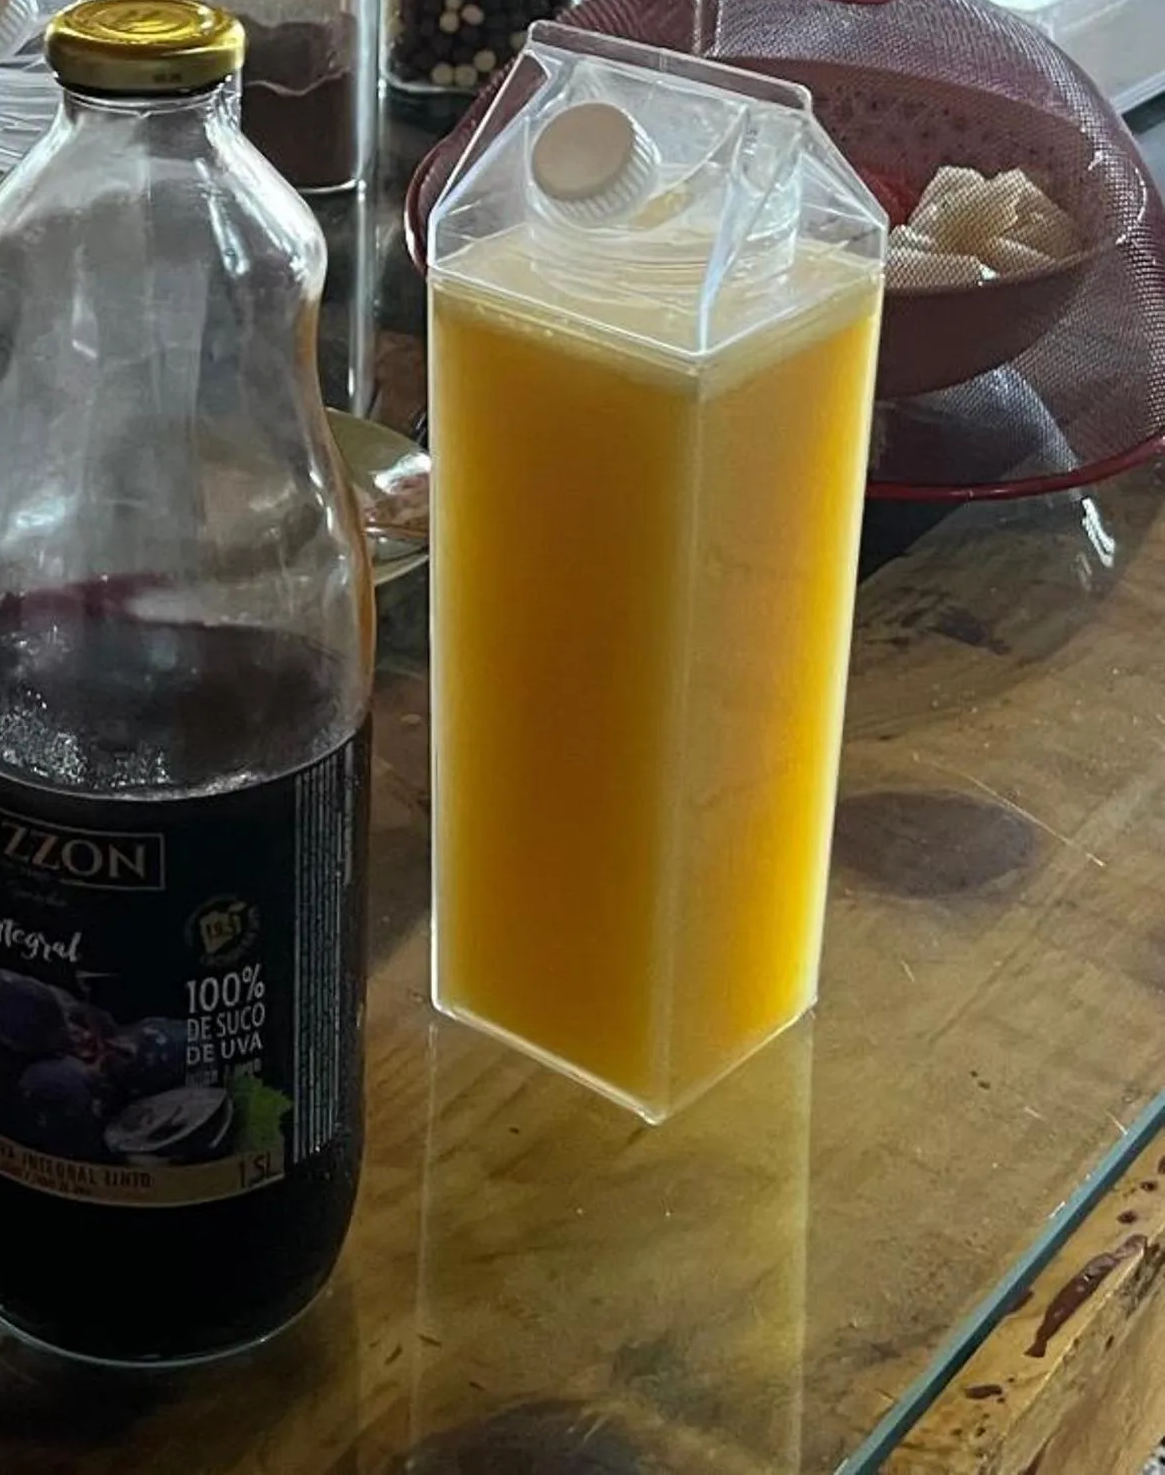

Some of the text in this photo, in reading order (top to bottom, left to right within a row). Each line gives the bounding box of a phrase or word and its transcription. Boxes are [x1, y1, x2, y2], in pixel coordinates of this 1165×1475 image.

[185, 963, 266, 1014] 100%
[186, 1002, 266, 1043] DE SUCO
[186, 1032, 265, 1066] DE UVA
